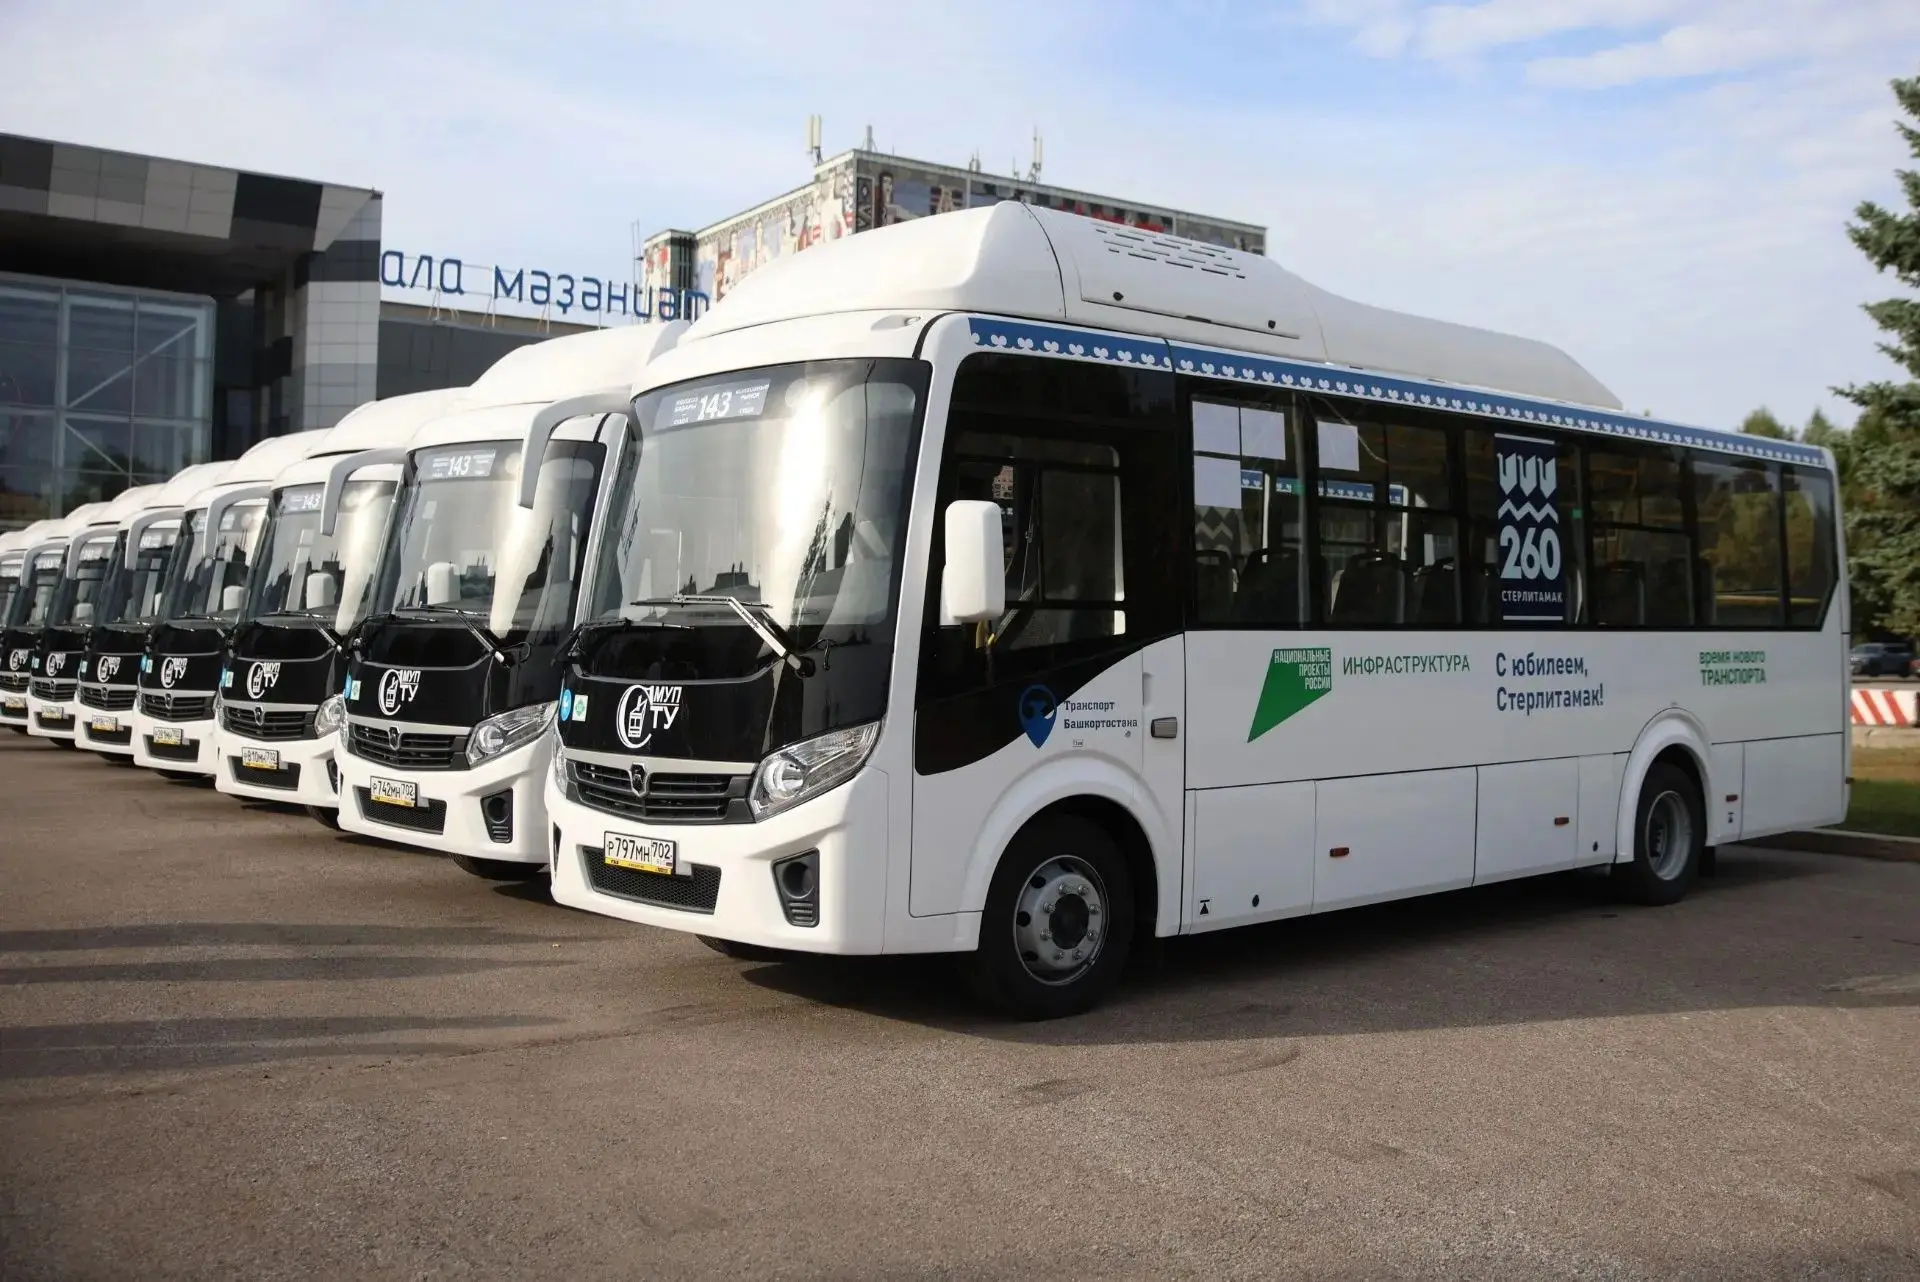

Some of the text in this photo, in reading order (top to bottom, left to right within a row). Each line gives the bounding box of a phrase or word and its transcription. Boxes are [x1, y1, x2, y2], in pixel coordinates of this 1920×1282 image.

[697, 391, 733, 420] 143
[448, 456, 471, 476] 143
[1500, 525, 1561, 580] 260
[1501, 590, 1563, 603] СТЕРЛИТАМАК
[1274, 650, 1330, 664] НАЦИОНАЛЬНЫЕ
[1343, 655, 1470, 675] ИНФРАСТРУКТУРА
[1496, 652, 1588, 677] С юбилеем,
[402, 670, 421, 683] МУП
[1299, 663, 1330, 676] ПРОЕКТЫ
[1700, 668, 1766, 685] ТРАНСПОРТА
[264, 673, 278, 688] ТУ
[1305, 677, 1330, 689] РОССИИ
[400, 685, 418, 702] ТУ
[653, 686, 682, 703] МУП
[1496, 683, 1604, 715] Стерлитамак!
[1064, 701, 1115, 712] Транспорт
[650, 706, 679, 729] ТУ
[1064, 719, 1138, 730] Башкортостана
[608, 837, 670, 862] Р797МН 702
